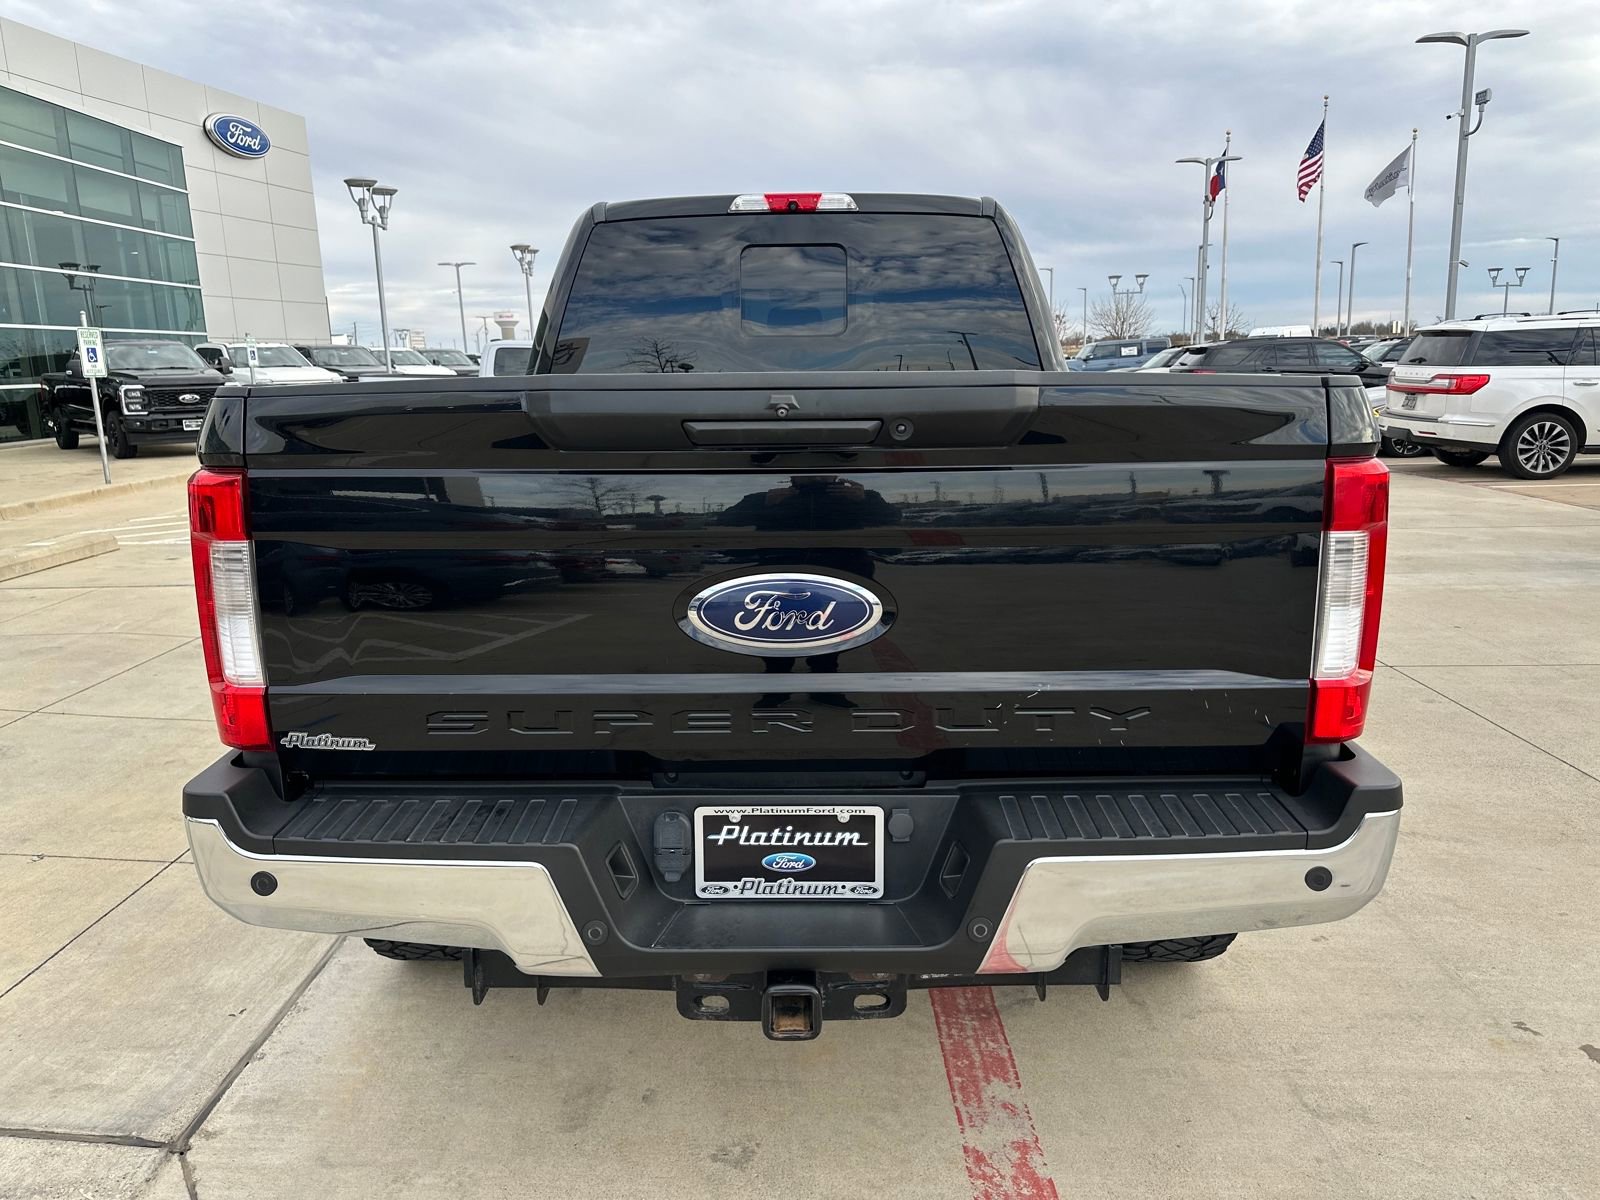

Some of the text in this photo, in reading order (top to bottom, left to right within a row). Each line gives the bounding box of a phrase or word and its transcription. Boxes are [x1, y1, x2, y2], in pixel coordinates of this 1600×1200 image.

[227, 122, 261, 150] Ford
[734, 590, 837, 631] Ford
[426, 707, 1150, 735] SUPER DUTY
[280, 732, 376, 751] Platinum
[713, 807, 867, 815] www.PlatinumFord.com
[707, 825, 870, 846] Platinum
[772, 855, 806, 869] Ford
[738, 878, 847, 896] Platinum
